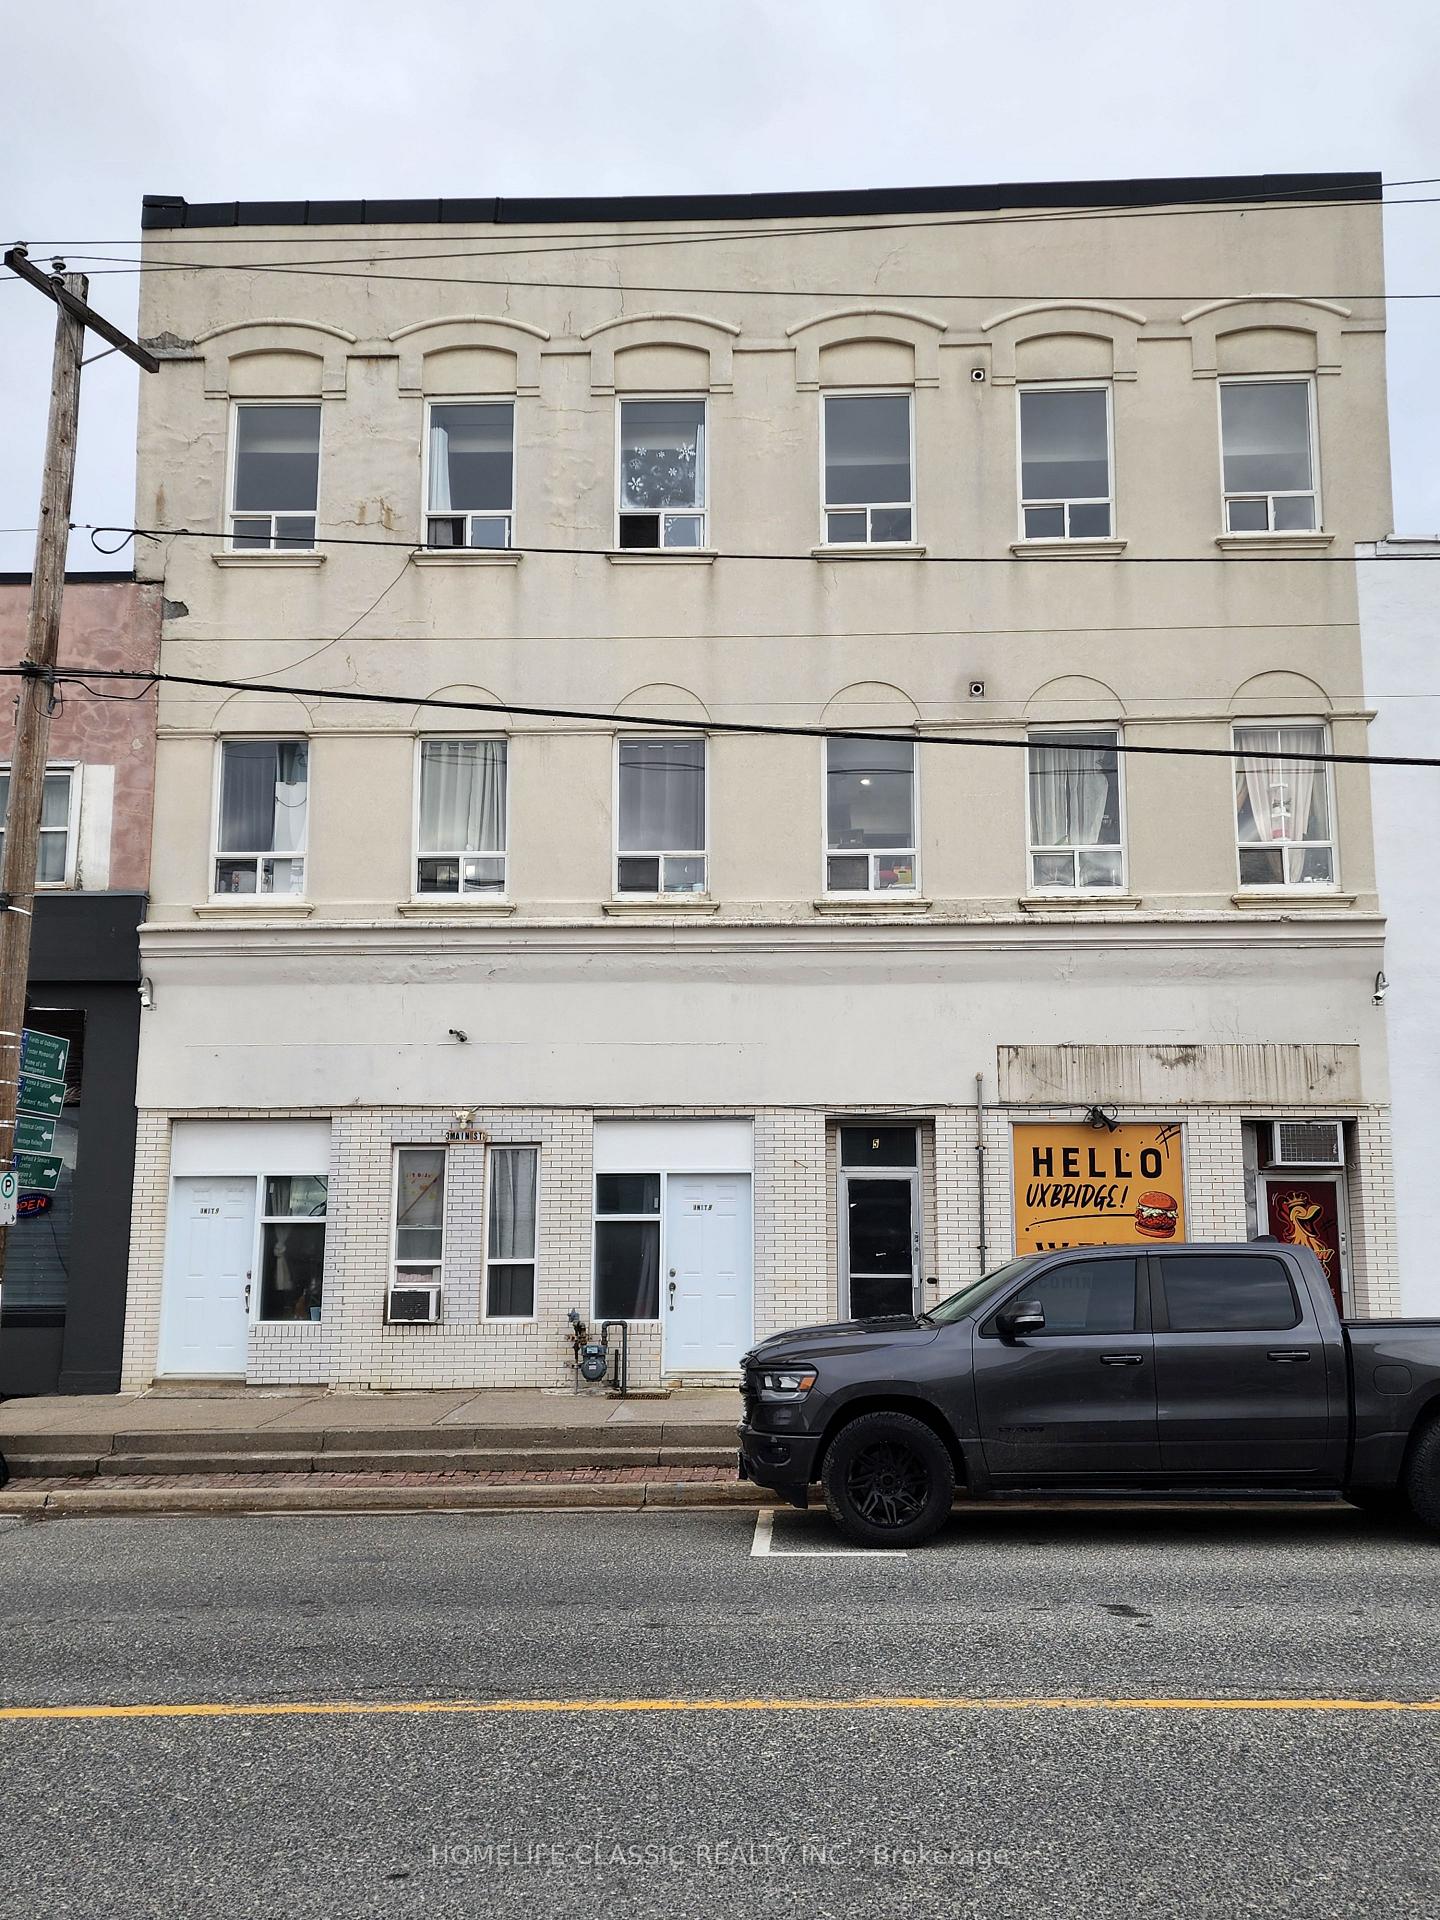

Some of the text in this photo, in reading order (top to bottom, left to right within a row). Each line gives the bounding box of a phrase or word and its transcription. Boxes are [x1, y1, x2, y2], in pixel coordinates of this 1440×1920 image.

[873, 1138, 880, 1149] 5
[1032, 1147, 1162, 1178] HELLO
[5, 1179, 12, 1192] P
[1026, 1183, 1128, 1211] UXBRIDGE!
